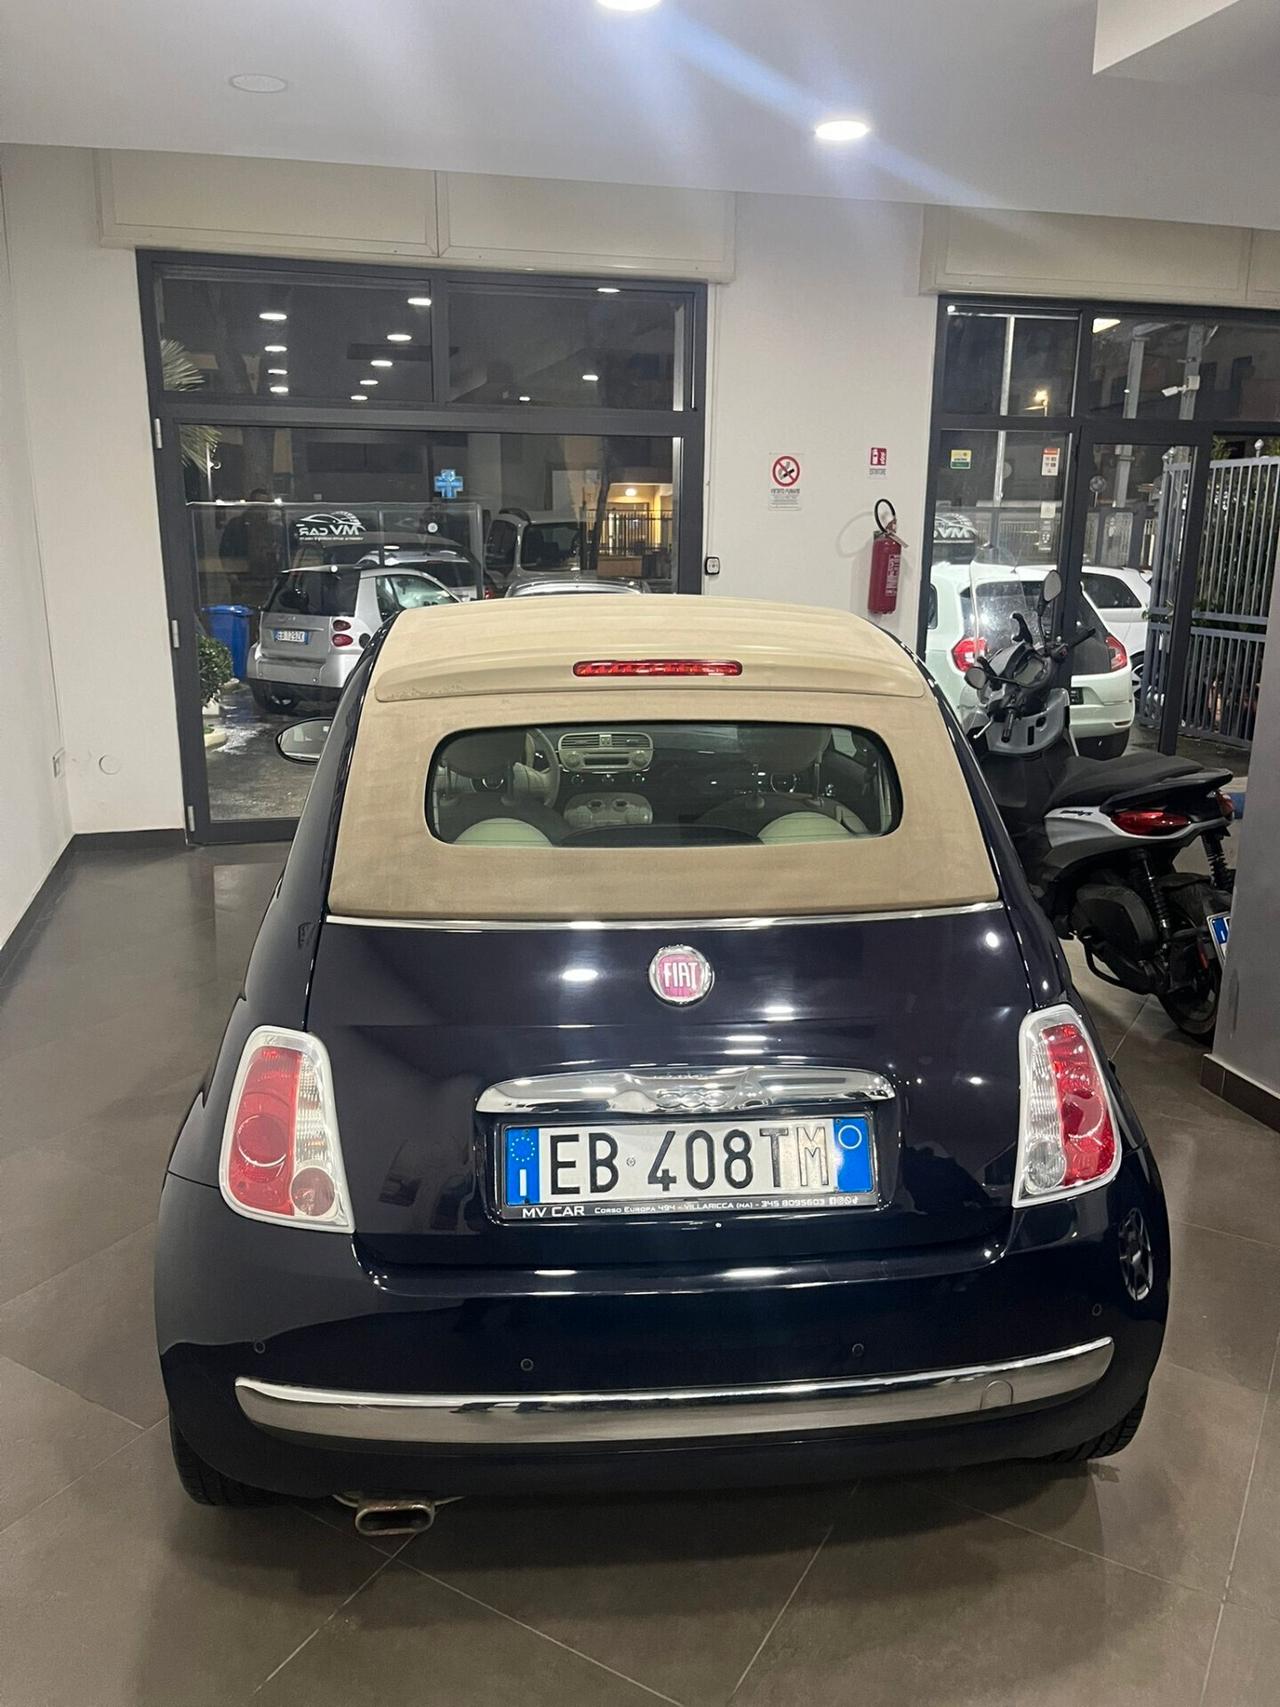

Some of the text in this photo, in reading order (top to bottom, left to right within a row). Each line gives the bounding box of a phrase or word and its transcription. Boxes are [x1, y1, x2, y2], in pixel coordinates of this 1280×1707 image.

[663, 961, 699, 991] FIAT
[550, 1131, 619, 1195] EB
[647, 1126, 829, 1191] 408TM
[522, 1206, 548, 1218] MV
[551, 1205, 585, 1217] CAR
